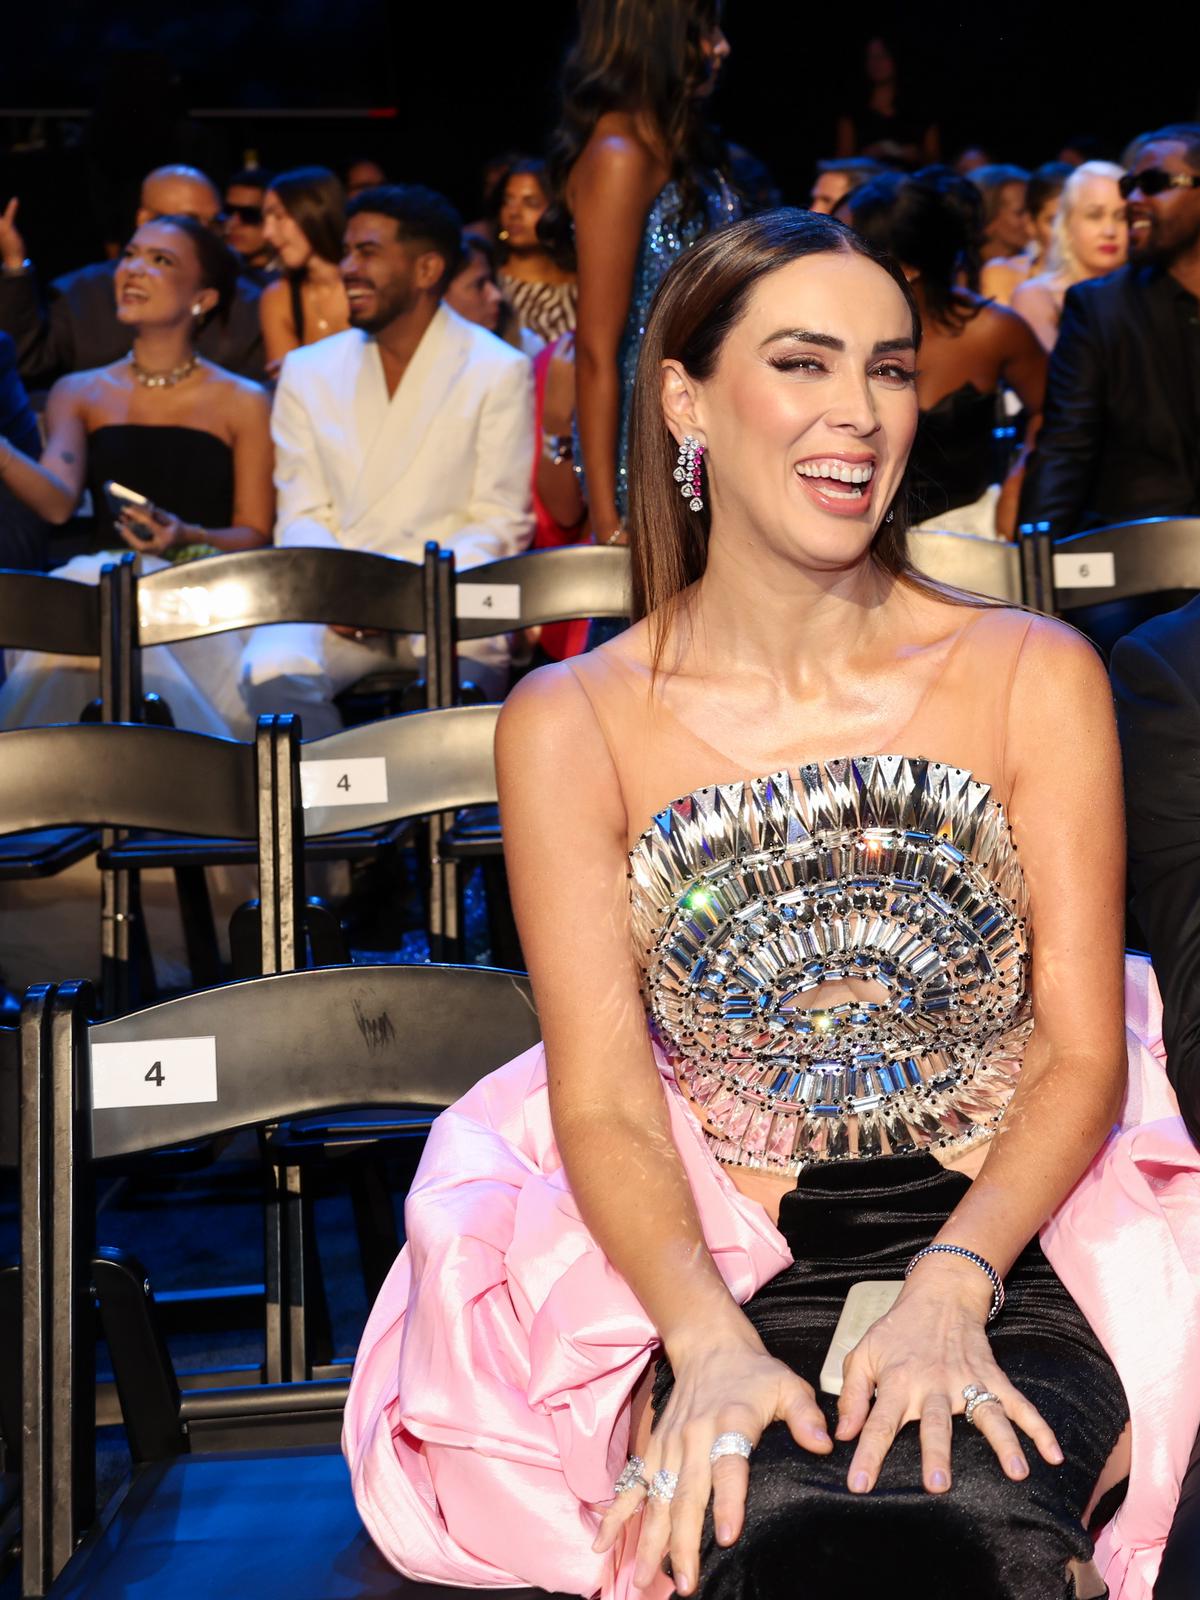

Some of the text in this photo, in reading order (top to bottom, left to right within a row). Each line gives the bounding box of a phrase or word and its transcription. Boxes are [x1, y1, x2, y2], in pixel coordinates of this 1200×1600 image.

[1078, 564, 1090, 578] 6
[482, 595, 493, 608] 4
[336, 774, 352, 792] 4
[144, 1061, 166, 1087] 4
